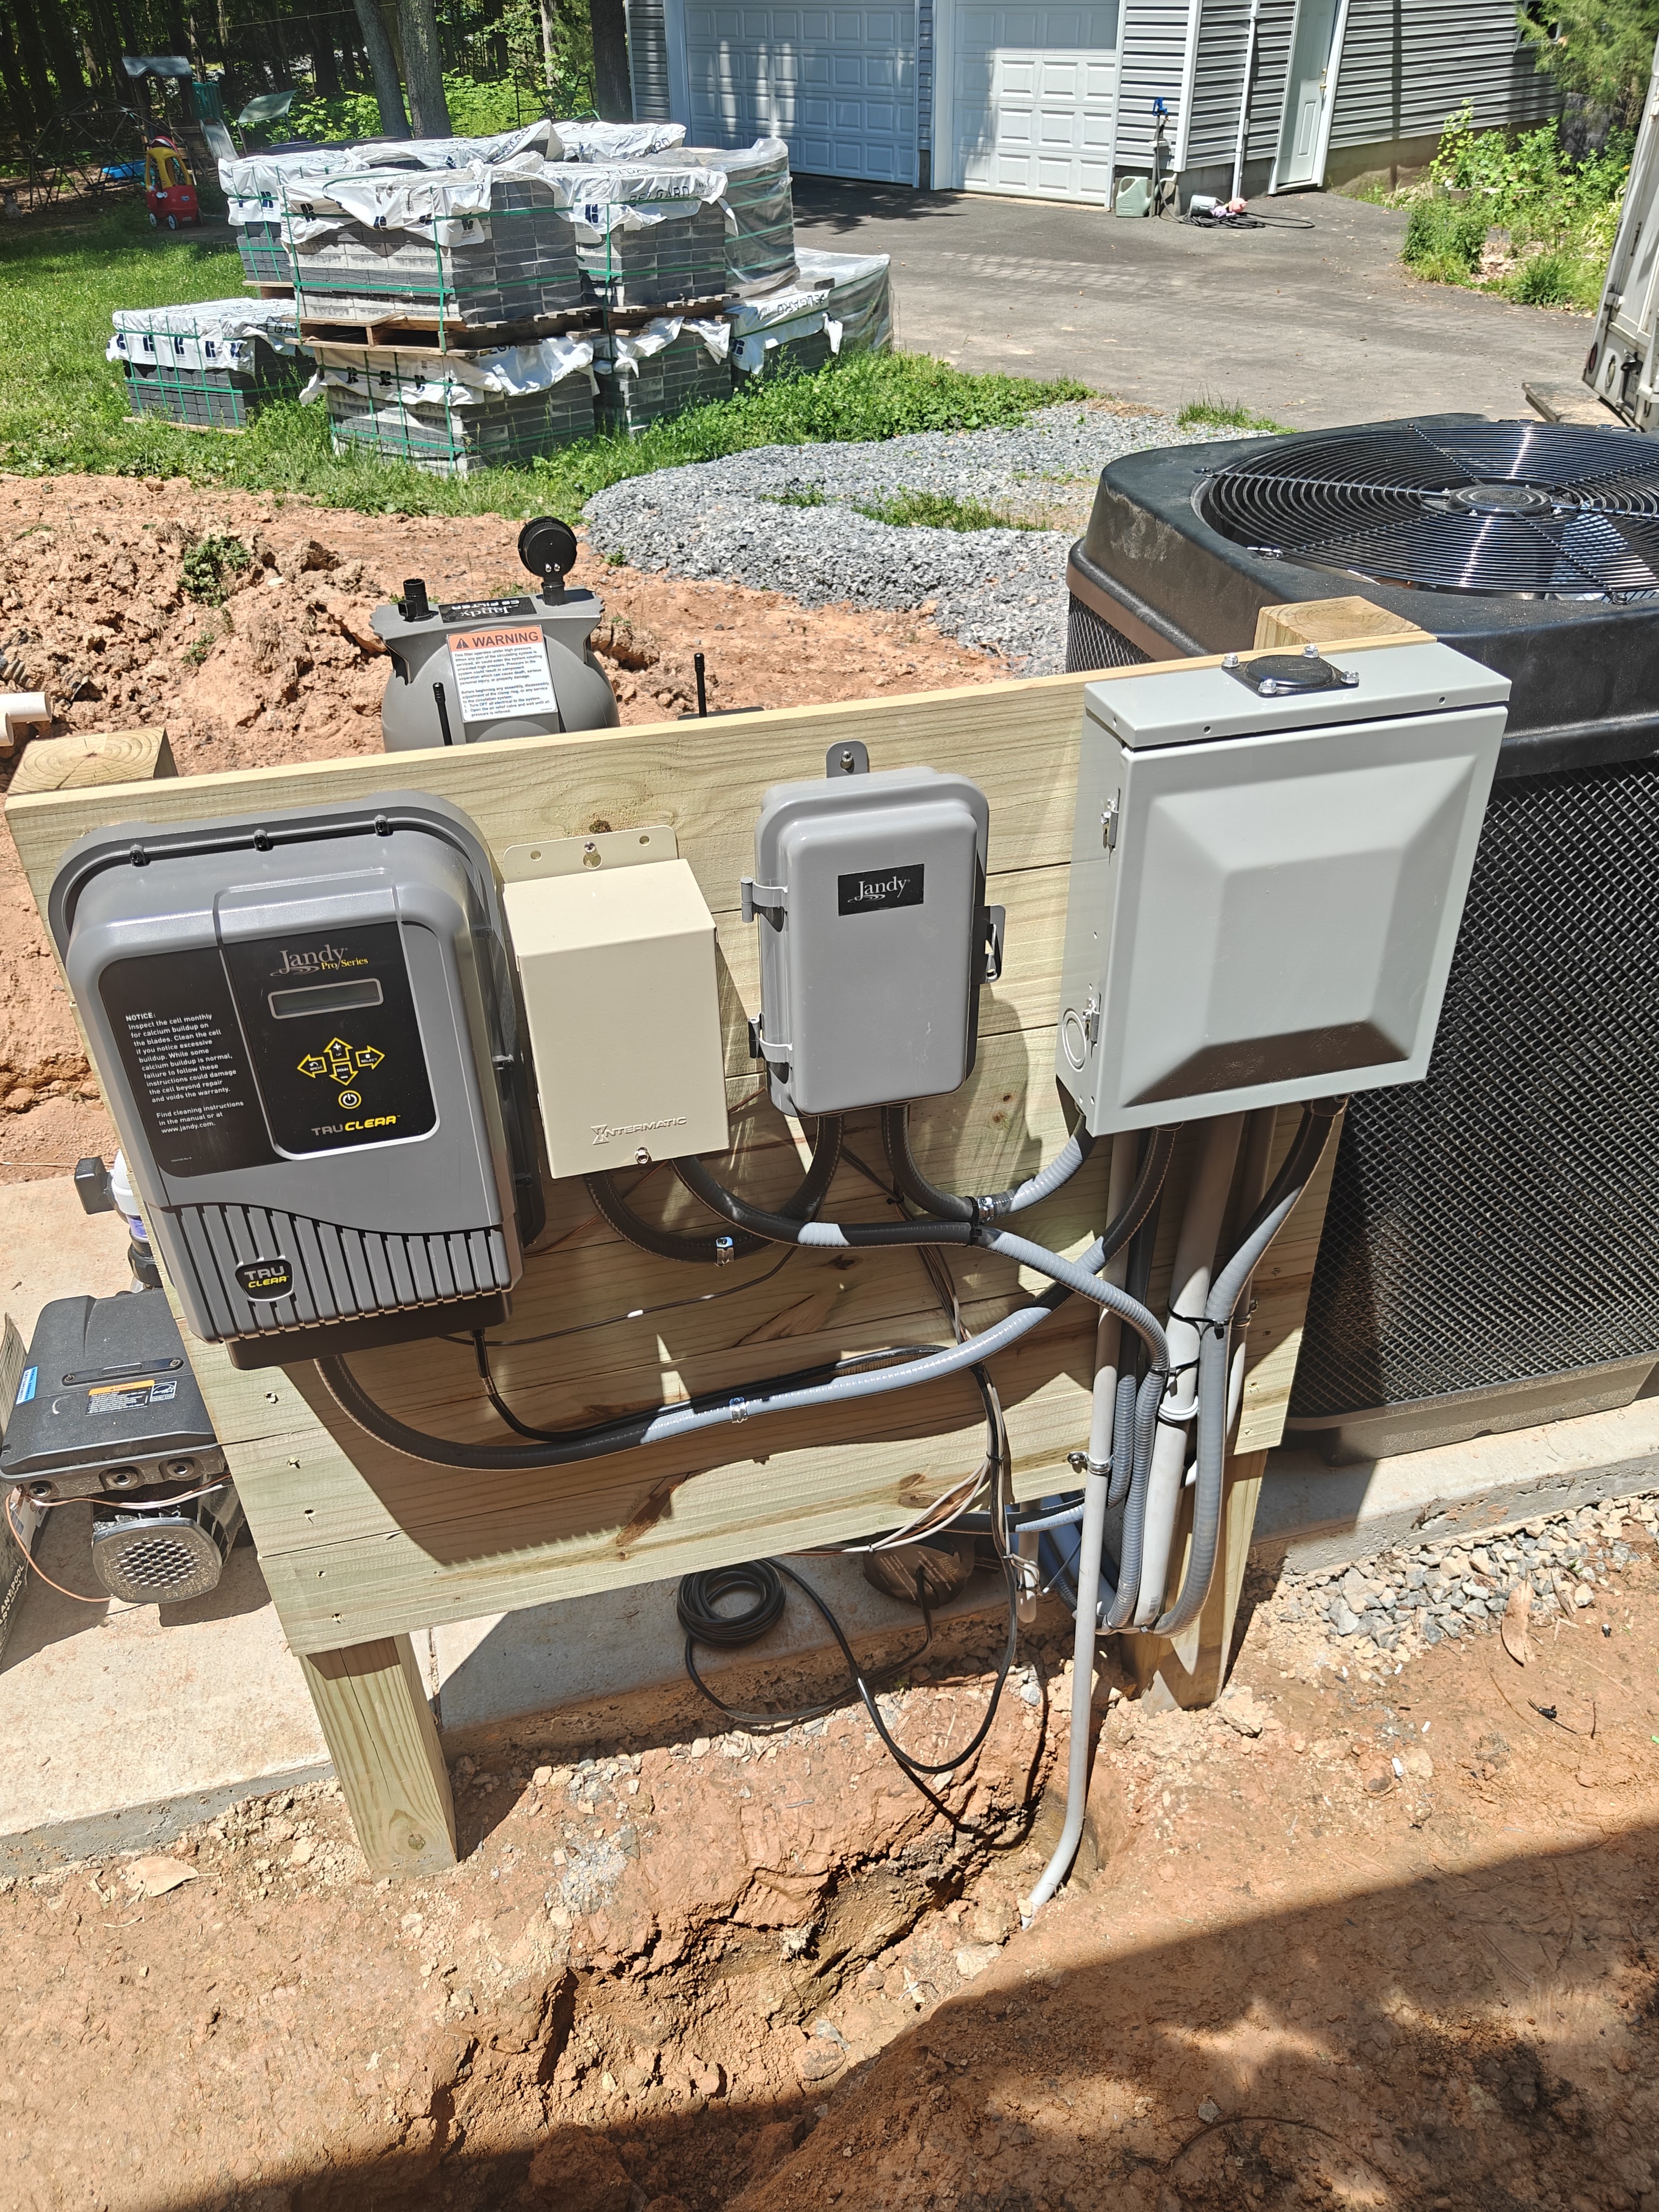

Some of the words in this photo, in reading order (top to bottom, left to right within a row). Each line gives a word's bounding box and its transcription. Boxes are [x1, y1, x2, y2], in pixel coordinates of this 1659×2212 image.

[451, 602, 498, 610] FILTER
[472, 631, 538, 647] WARNING
[854, 876, 907, 901] Jandy
[279, 944, 345, 974] Jandy
[341, 957, 368, 967] Series
[125, 1012, 156, 1021] NOTICE:
[128, 1021, 154, 1030] Inspect
[183, 1013, 212, 1022] monthly
[143, 1028, 171, 1036] calcium
[171, 1024, 198, 1033] buildup
[179, 1040, 212, 1048] excessive
[138, 1055, 167, 1063] buildup.
[141, 1063, 168, 1071] calcium
[205, 1052, 233, 1062] normal,
[146, 1077, 188, 1087] instructions
[189, 1073, 208, 1081] could
[209, 1069, 237, 1077] damage
[176, 1082, 200, 1091] beyond
[197, 1087, 230, 1096] warranty.
[173, 1108, 202, 1116] cleaning
[203, 1101, 244, 1111] instructions
[179, 1114, 206, 1123] manual
[161, 1122, 215, 1134] www.jandy.com.
[244, 1265, 285, 1280] TRU
[248, 1276, 287, 1289] CLEAR
[11, 1564, 24, 1590] POOL
